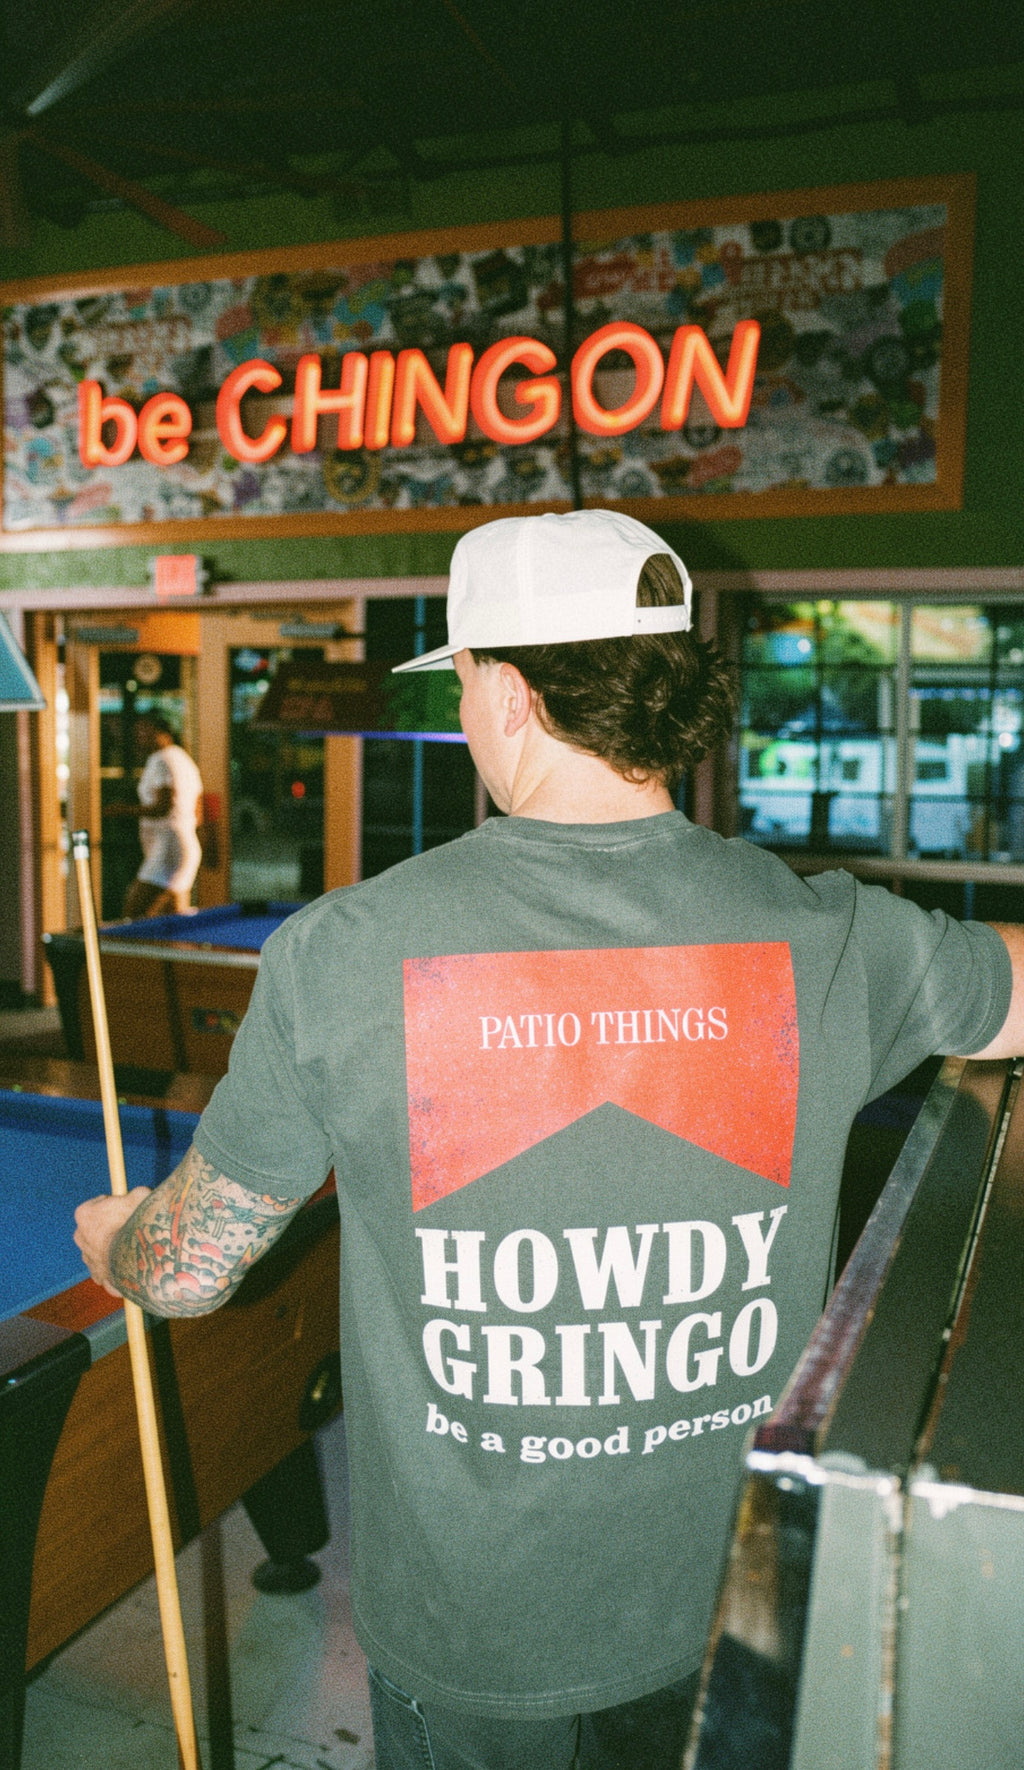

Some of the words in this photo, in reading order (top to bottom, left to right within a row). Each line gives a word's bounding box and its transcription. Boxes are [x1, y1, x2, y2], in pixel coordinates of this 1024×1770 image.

[77, 379, 192, 469] be
[215, 320, 761, 464] CHINGON
[478, 1012, 582, 1050] PATIO
[591, 1006, 729, 1045] THINGS
[415, 1205, 788, 1313] HOWDY
[422, 1298, 778, 1406] GRINGO
[425, 1402, 469, 1443] be
[480, 1431, 506, 1453] a
[520, 1426, 630, 1464] good
[642, 1394, 774, 1455] person
